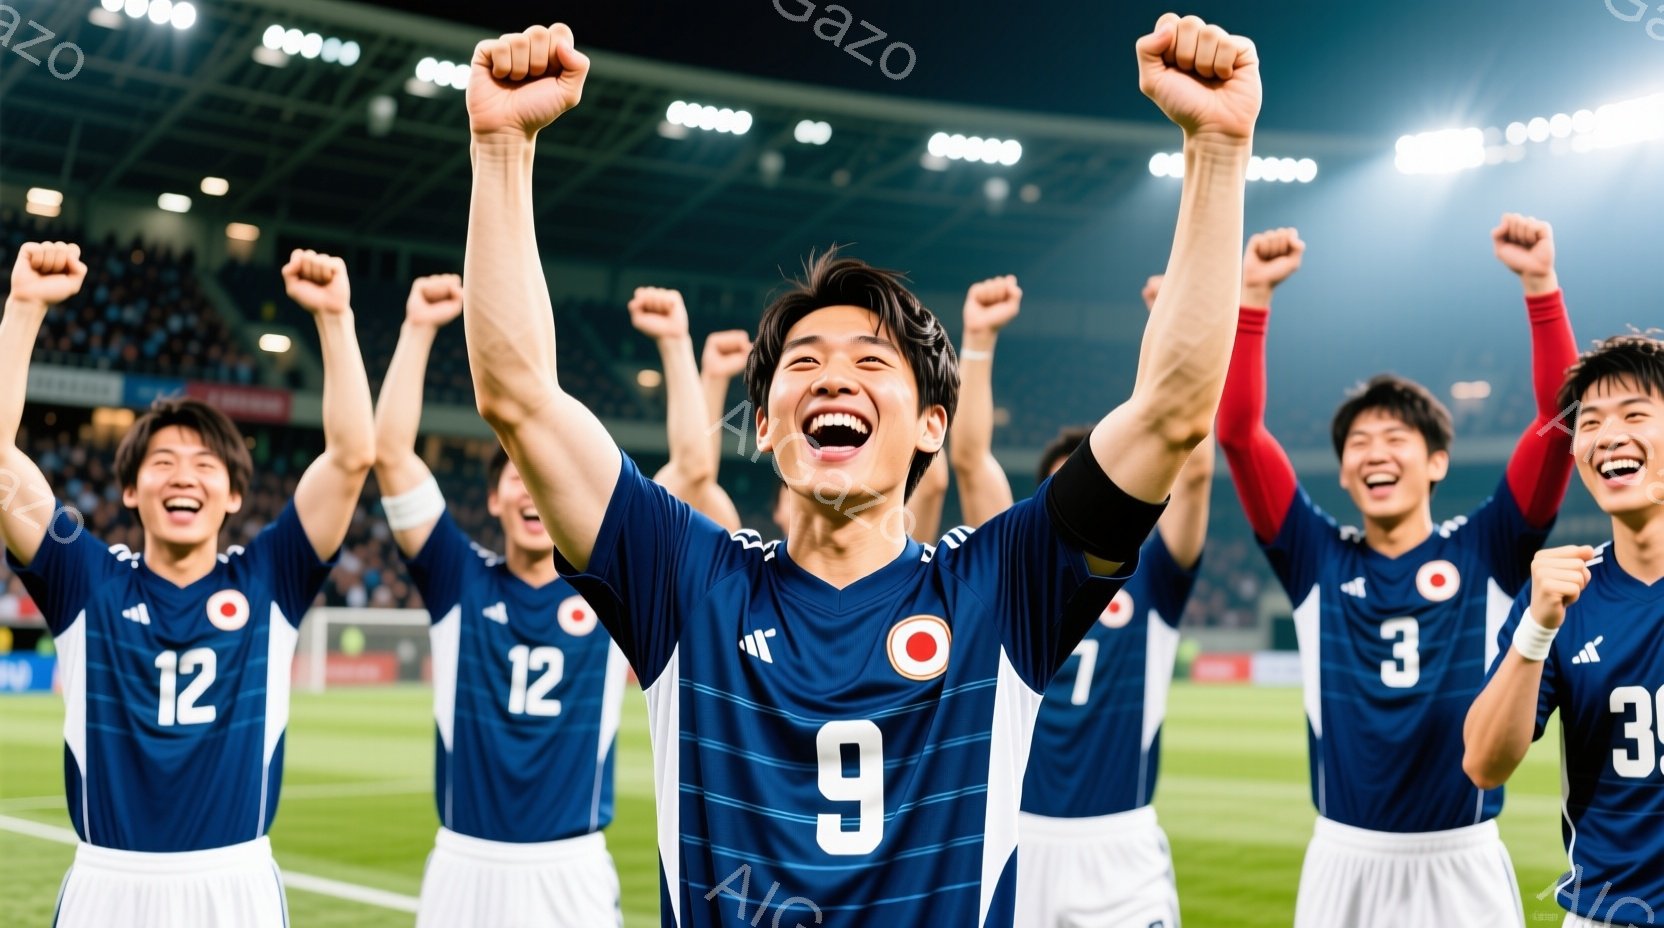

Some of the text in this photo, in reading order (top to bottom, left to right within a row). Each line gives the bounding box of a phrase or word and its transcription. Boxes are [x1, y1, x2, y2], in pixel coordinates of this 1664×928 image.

[154, 648, 217, 726] 12
[508, 644, 565, 717] 12
[1070, 639, 1100, 706] 7
[1380, 617, 1420, 688] 3
[1609, 684, 1664, 778] 3
[816, 719, 884, 856] 9
